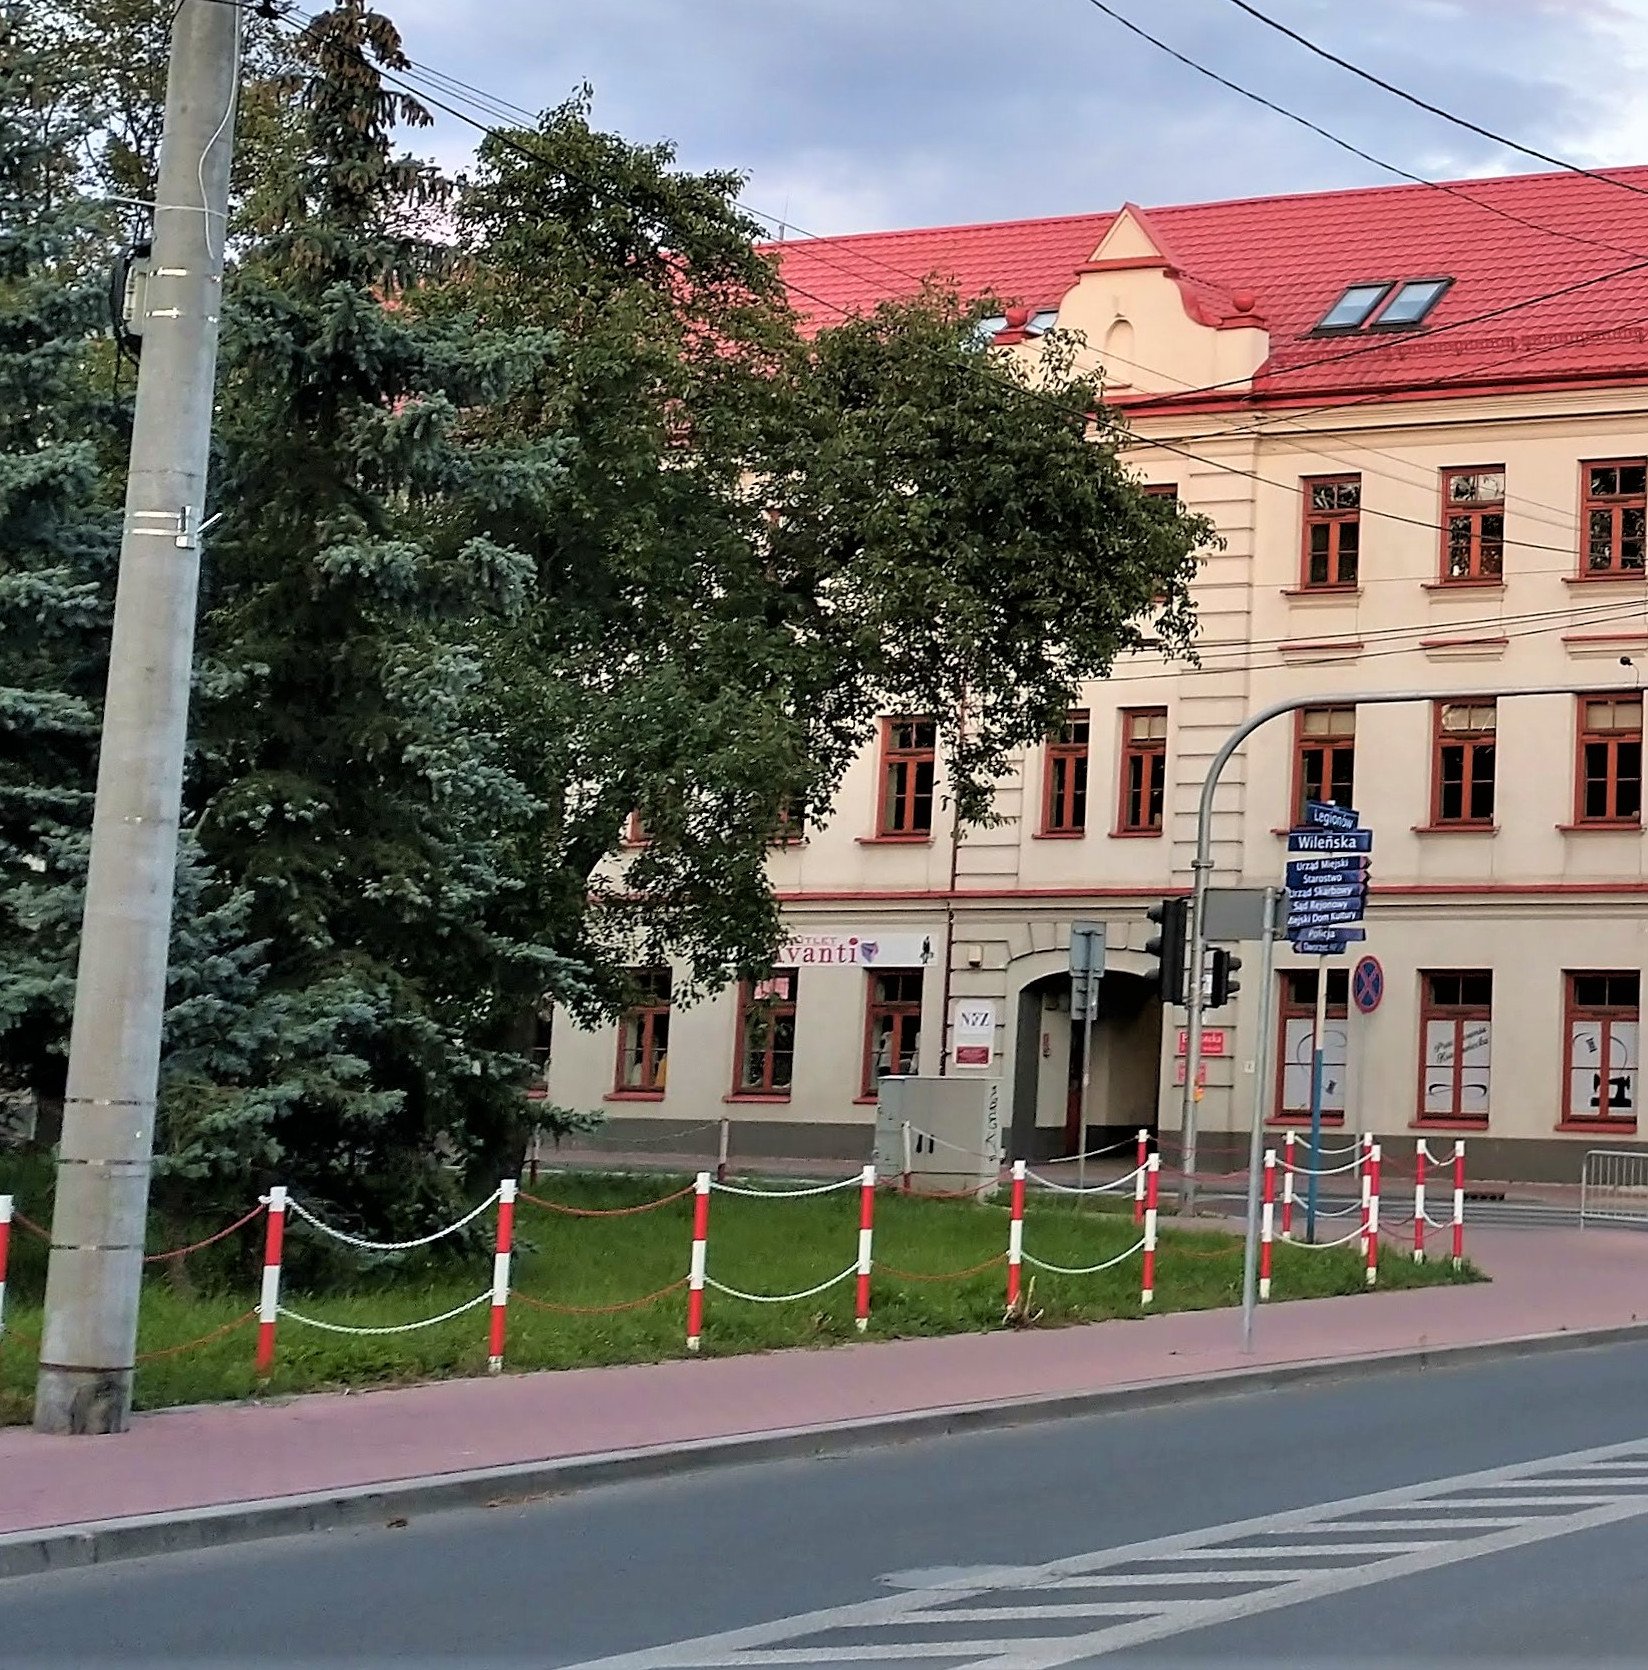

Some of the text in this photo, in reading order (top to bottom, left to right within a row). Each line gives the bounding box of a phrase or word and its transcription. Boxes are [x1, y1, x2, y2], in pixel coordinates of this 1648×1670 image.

[1314, 808, 1354, 829] Legionów
[1298, 835, 1357, 849] Wileńska
[1296, 859, 1349, 871] Urząd Miejski
[1303, 874, 1342, 884] Starostwo
[1312, 913, 1329, 923] Dom
[1330, 911, 1357, 921] Kultury
[1308, 930, 1336, 942] Policja
[961, 1011, 990, 1027] NFZ
